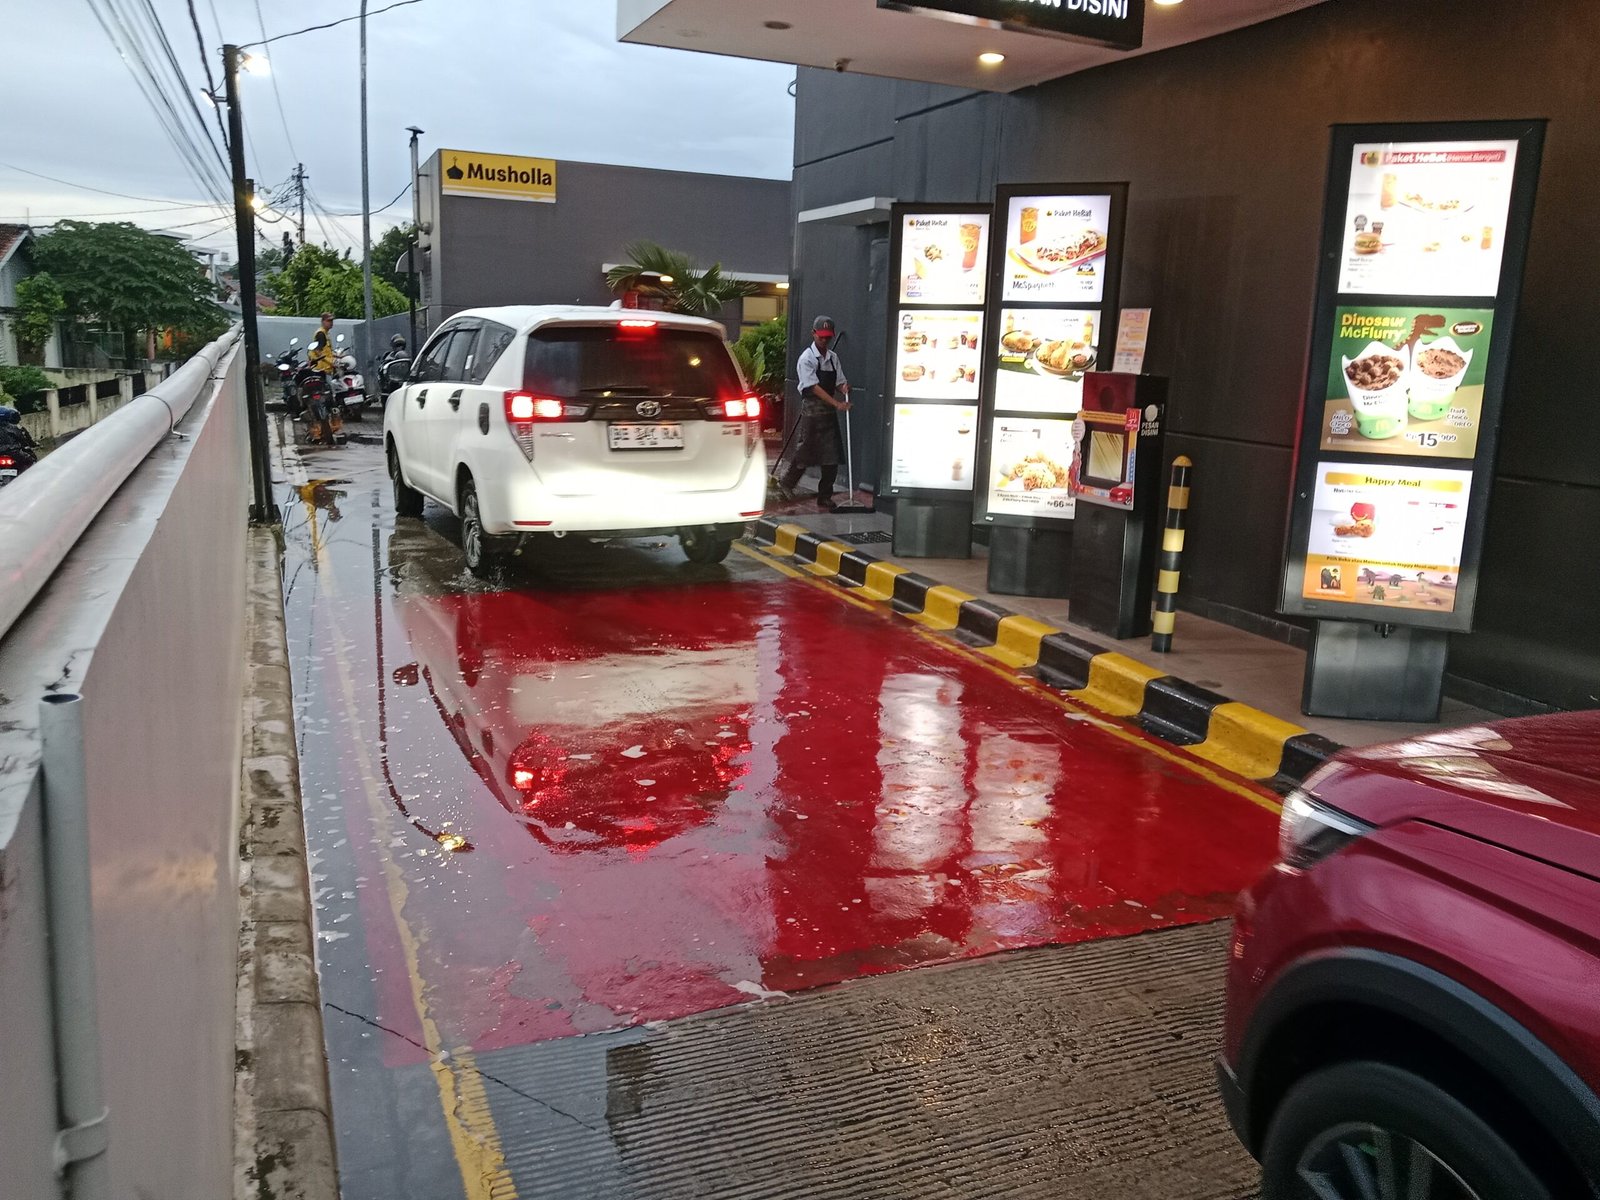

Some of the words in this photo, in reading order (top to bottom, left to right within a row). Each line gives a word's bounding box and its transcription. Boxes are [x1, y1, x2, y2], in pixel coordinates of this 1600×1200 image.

[1067, 0, 1128, 19] DISINI
[467, 163, 552, 186] Musholla
[1341, 313, 1406, 327] Dinosaur
[1340, 327, 1406, 342] McFlurry
[1365, 476, 1396, 486] Happy
[1397, 479, 1421, 488] Meal
